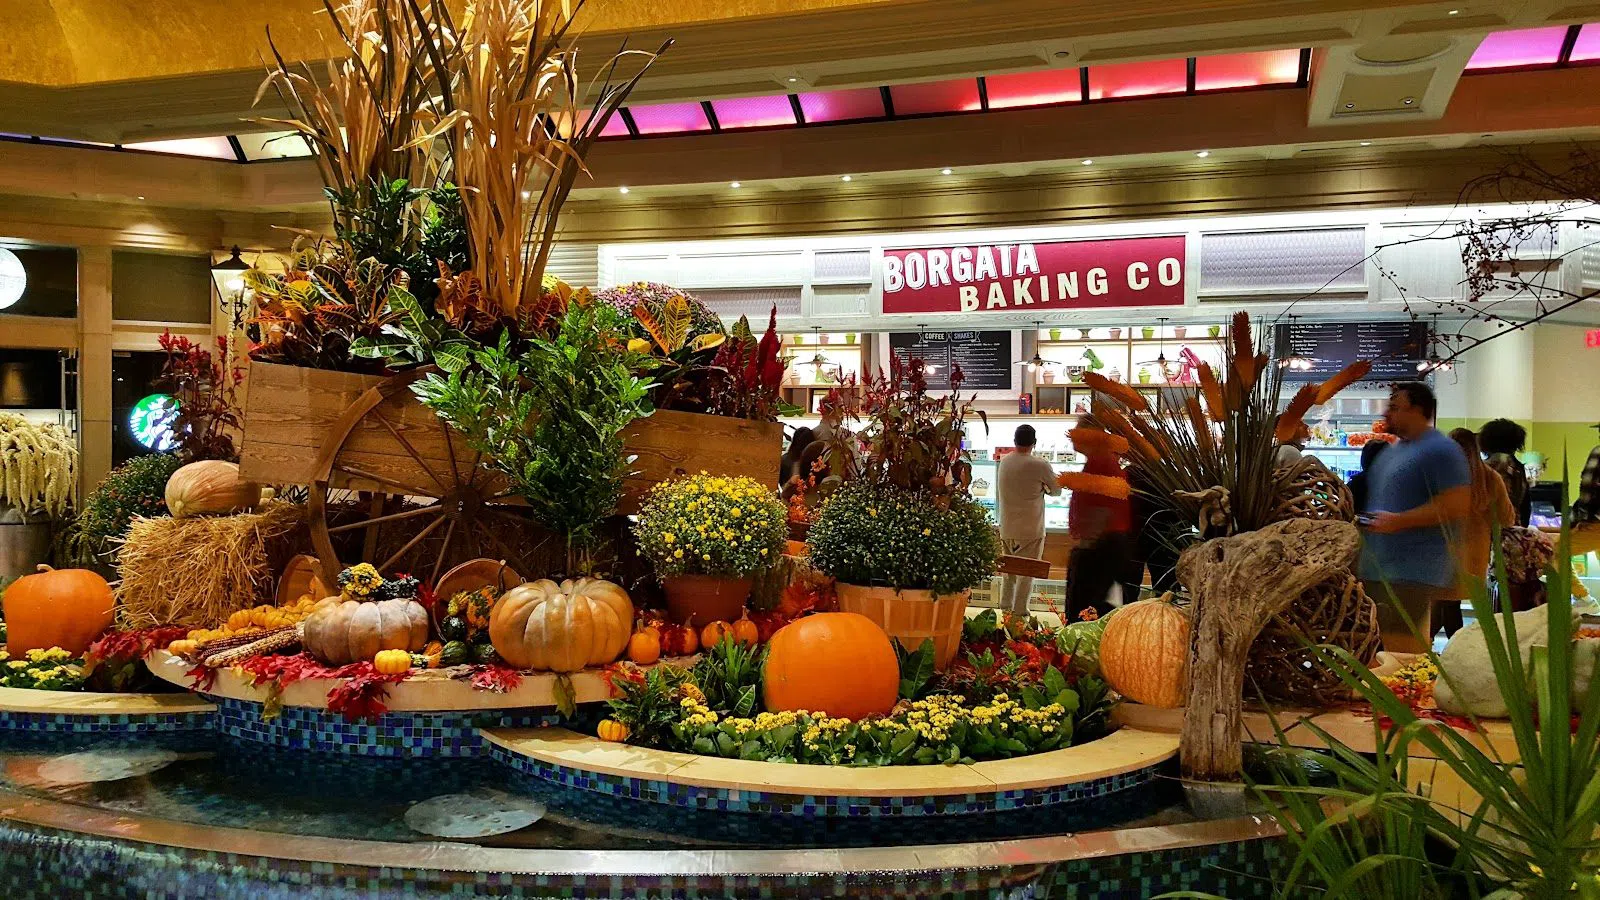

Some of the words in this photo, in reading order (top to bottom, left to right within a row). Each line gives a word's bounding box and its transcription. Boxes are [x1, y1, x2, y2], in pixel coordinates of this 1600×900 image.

[883, 243, 1040, 293] BORGATA
[959, 267, 1108, 312] BAKING
[1126, 257, 1181, 291] CO
[924, 332, 945, 340] COFFEE
[953, 331, 974, 339] SHAKES
